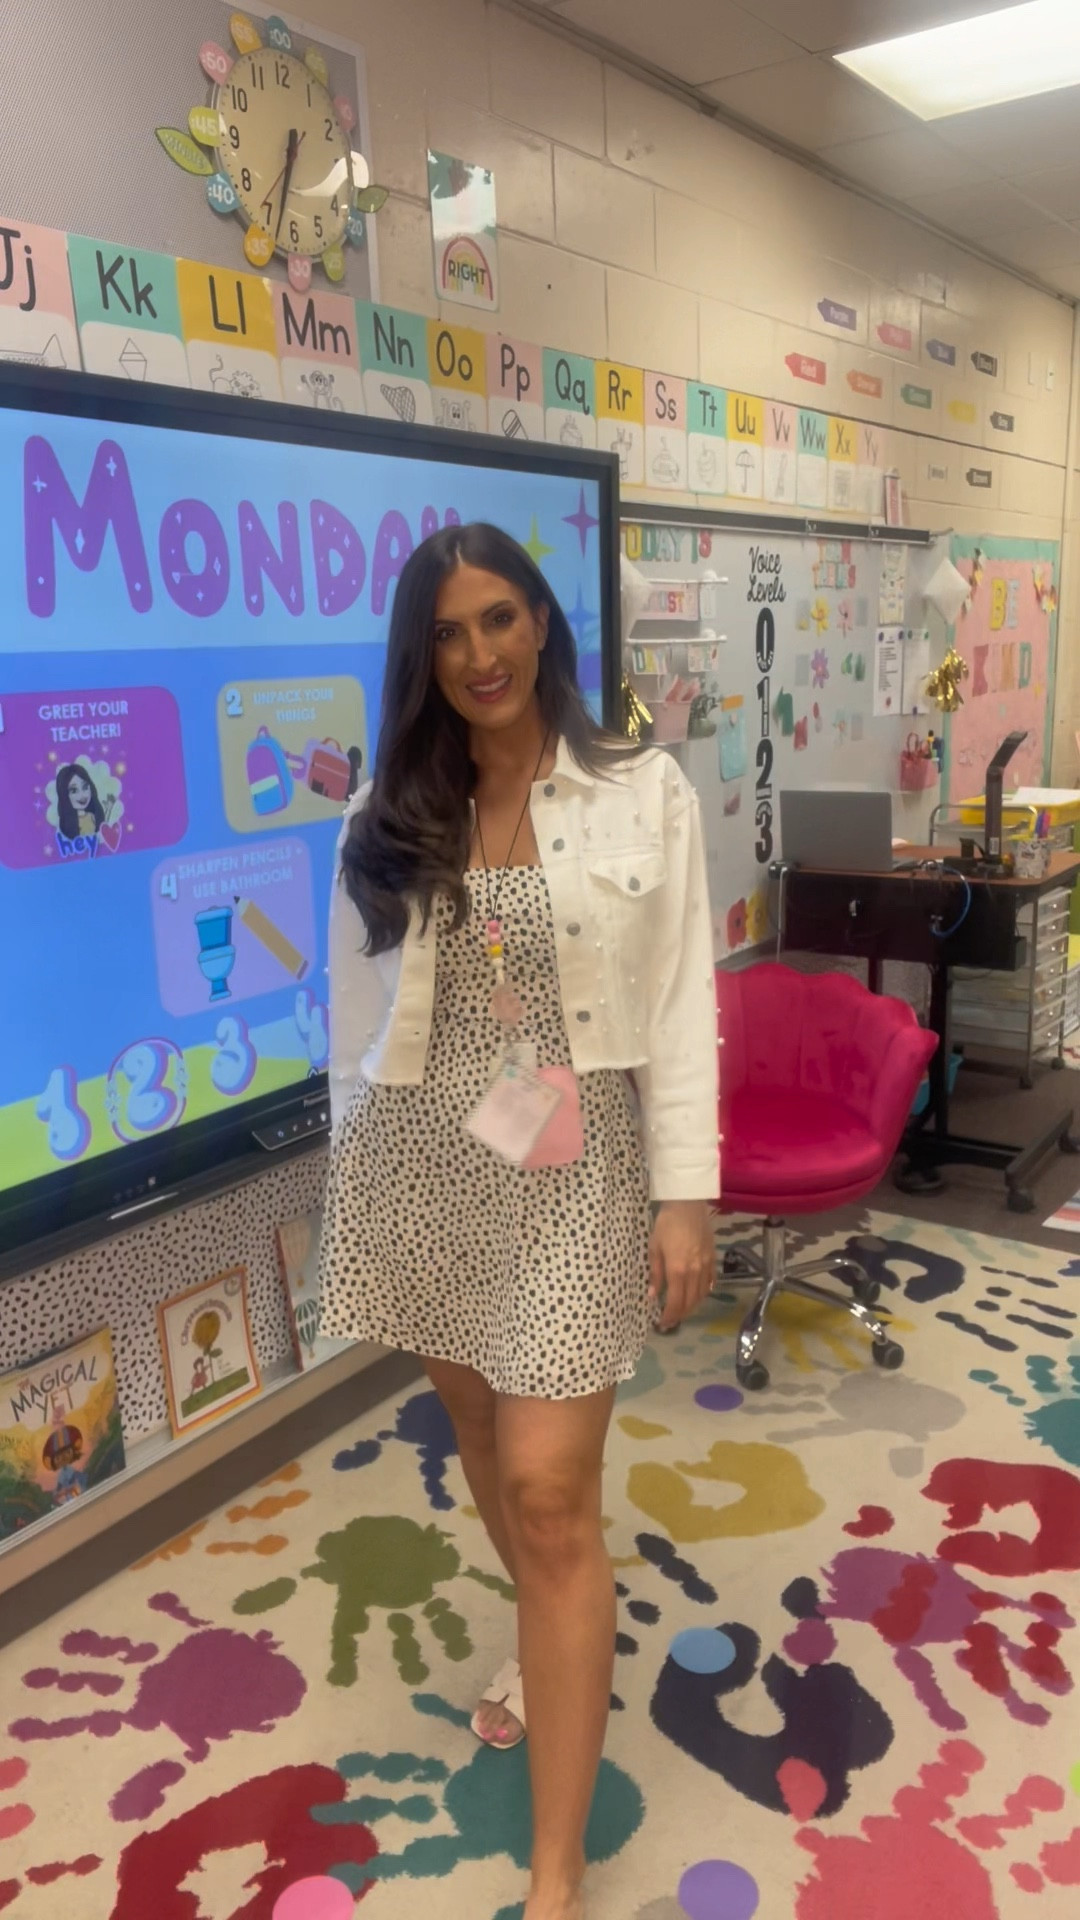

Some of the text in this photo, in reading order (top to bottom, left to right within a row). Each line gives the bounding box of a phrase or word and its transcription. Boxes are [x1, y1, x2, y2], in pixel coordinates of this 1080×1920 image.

[251, 63, 264, 90] 11
[275, 61, 290, 89] 12
[232, 85, 248, 112] 10
[306, 83, 312, 108] 1
[229, 125, 240, 149] 9
[324, 118, 333, 142] 2
[241, 168, 252, 191] 8
[208, 184, 235, 205] :40
[330, 195, 339, 217] 4
[263, 202, 272, 226] 7
[314, 215, 323, 238] 5
[290, 221, 299, 243] 6
[448, 260, 486, 285] RIGHT
[96, 250, 158, 319] Kk
[208, 274, 247, 335] Ll
[282, 292, 351, 356] Mm
[373, 311, 414, 368] Nn
[436, 330, 473, 381] Oo
[501, 343, 531, 402] Pp
[555, 358, 590, 416] Qq
[608, 370, 632, 411] Rr
[655, 380, 677, 421] Ss
[698, 389, 718, 428] Tt
[735, 398, 756, 436] Uu
[772, 408, 790, 443] Vv
[800, 415, 826, 450] Ww
[835, 423, 851, 455] Xx
[864, 428, 879, 466] Yy
[24, 435, 461, 618] MONDA
[620, 524, 688, 561] ODAY
[749, 546, 782, 574] Voice
[747, 575, 786, 603] Levels
[989, 579, 1020, 631] BE
[756, 607, 775, 673] 0
[972, 642, 1032, 697] KIND
[38, 700, 129, 721] GREET YOUR
[226, 688, 243, 717] 2
[757, 676, 770, 737] 1
[756, 739, 773, 800] 2
[56, 832, 98, 858] hey
[755, 801, 773, 864] 3
[178, 855, 238, 879] SHARPEN
[242, 846, 291, 868] PENCILS
[160, 873, 177, 901] 4
[193, 867, 293, 899] USE BATHROOM
[211, 1013, 258, 1096] 3
[123, 1041, 177, 1132] 2
[36, 1063, 92, 1161] 1
[10, 1356, 97, 1422] MAGICAL
[36, 1386, 73, 1424] YET
